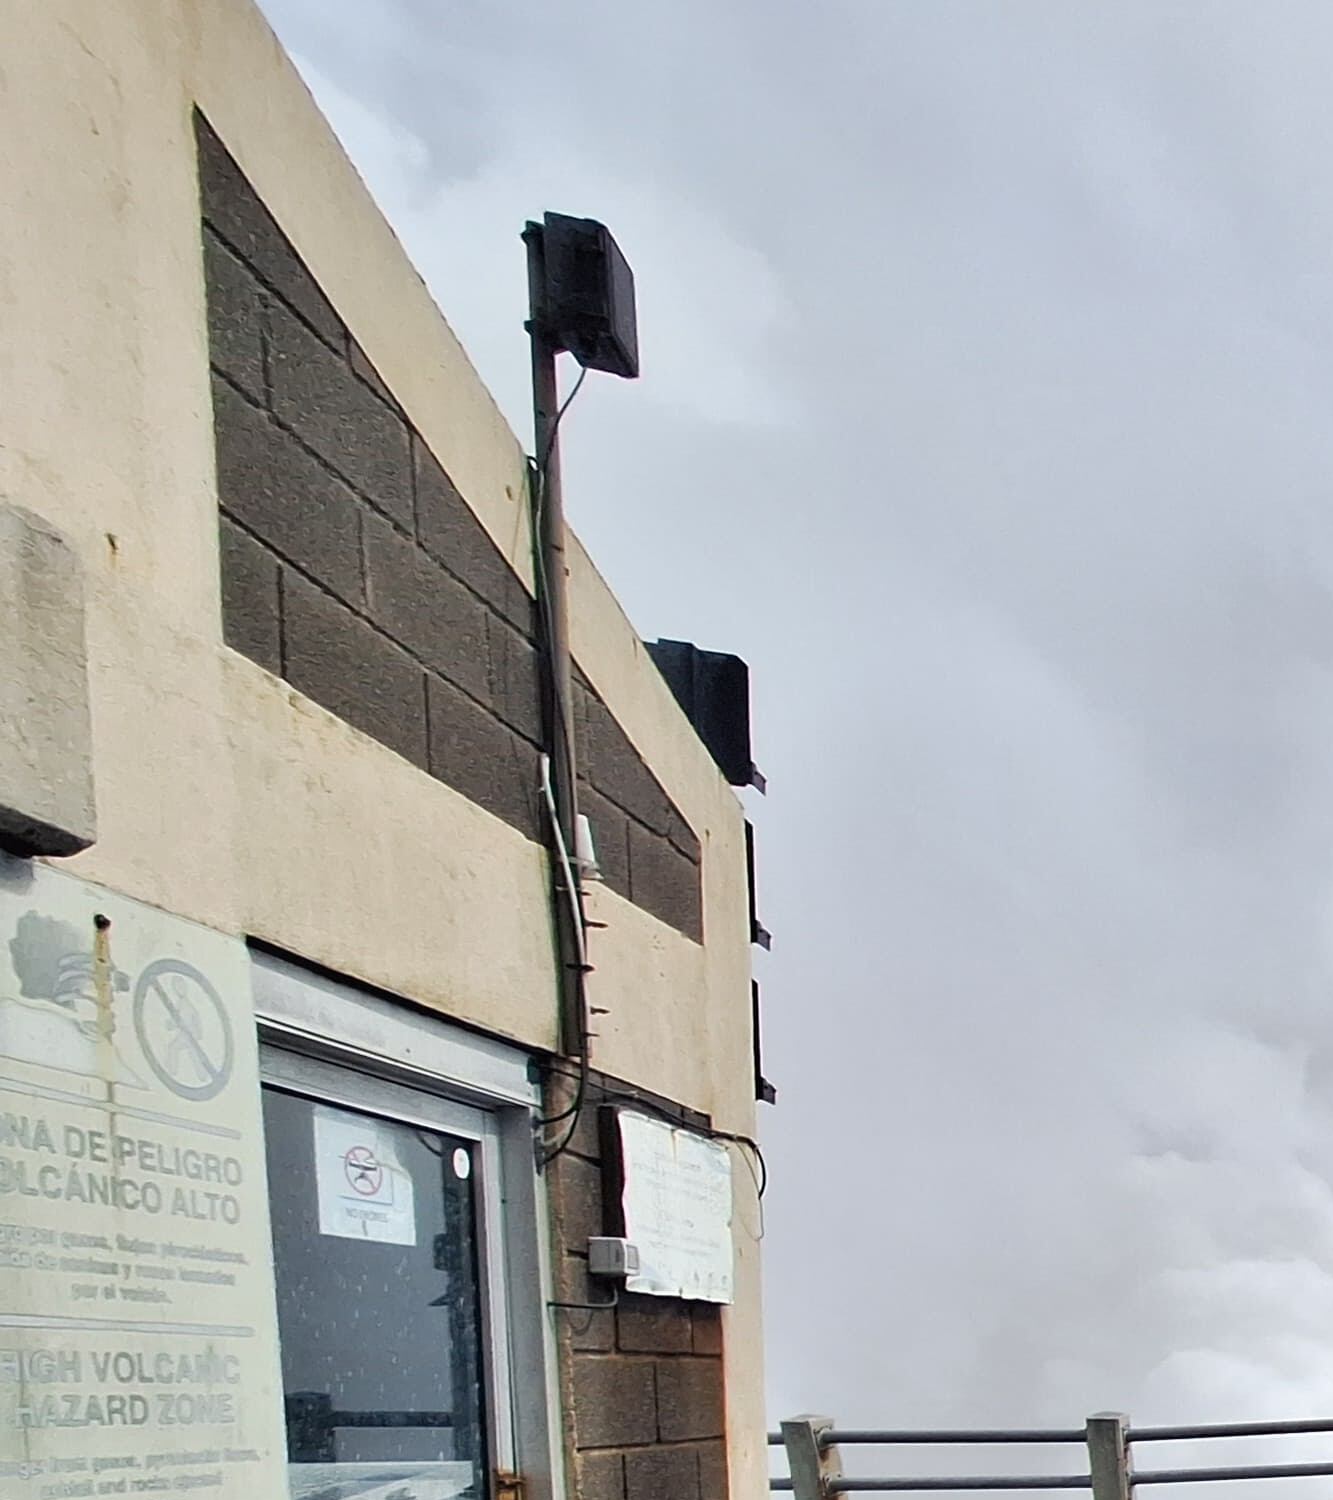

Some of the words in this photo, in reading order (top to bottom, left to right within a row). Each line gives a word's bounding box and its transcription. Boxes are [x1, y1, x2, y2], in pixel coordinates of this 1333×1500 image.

[64, 1125, 107, 1162] DE
[112, 1135, 242, 1186] PELIGRO
[171, 1187, 240, 1225] ALTO
[92, 1344, 241, 1385] VOLCANIC
[156, 1392, 236, 1425] ZONE
